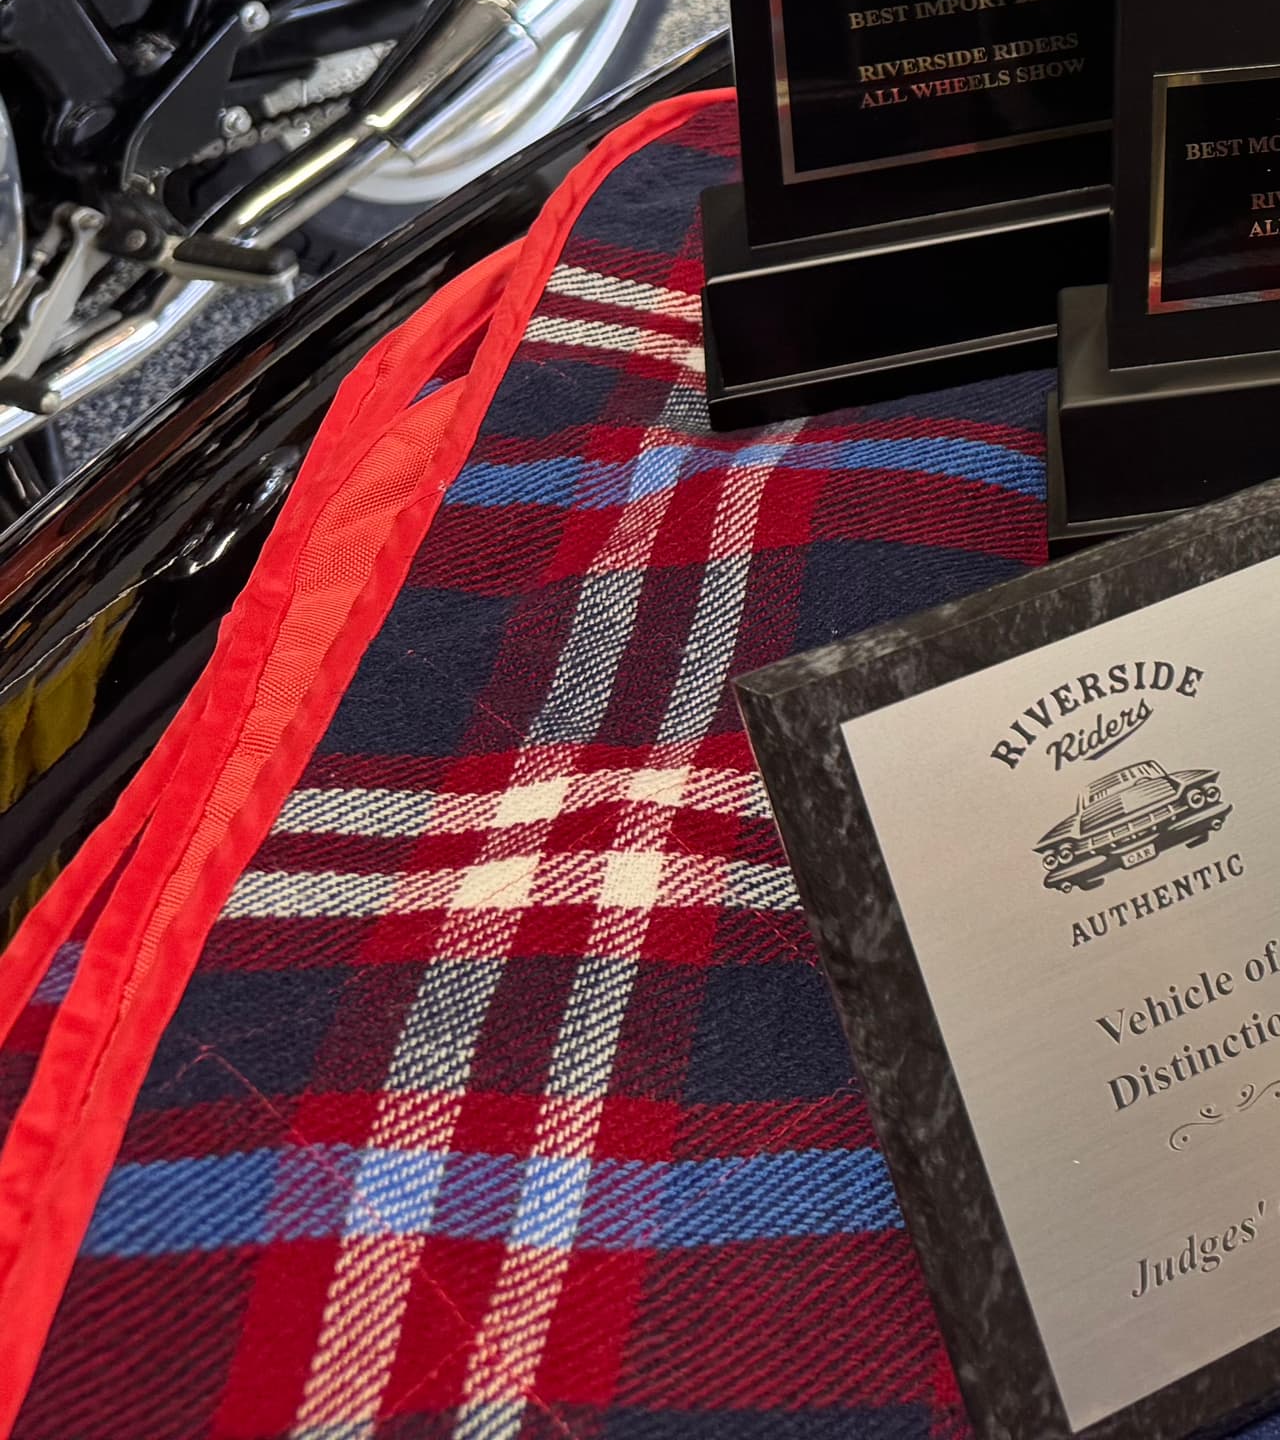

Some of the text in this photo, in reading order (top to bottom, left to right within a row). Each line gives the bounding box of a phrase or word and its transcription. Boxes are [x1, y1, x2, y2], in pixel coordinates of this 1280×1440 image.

[848, 4, 908, 29] BEST
[858, 32, 1078, 82] RIVERSIDE RIDERS
[859, 57, 1085, 109] ALL WHEELS SHOW
[1185, 139, 1243, 160] BEST
[990, 661, 1205, 769] RIVERSIDE
[1046, 698, 1154, 771] Riders
[1127, 848, 1153, 864] CAR
[1070, 853, 1245, 947] AUTHENTIC
[1095, 969, 1235, 1046] Vehicle
[1130, 1200, 1266, 1298] Judges'
